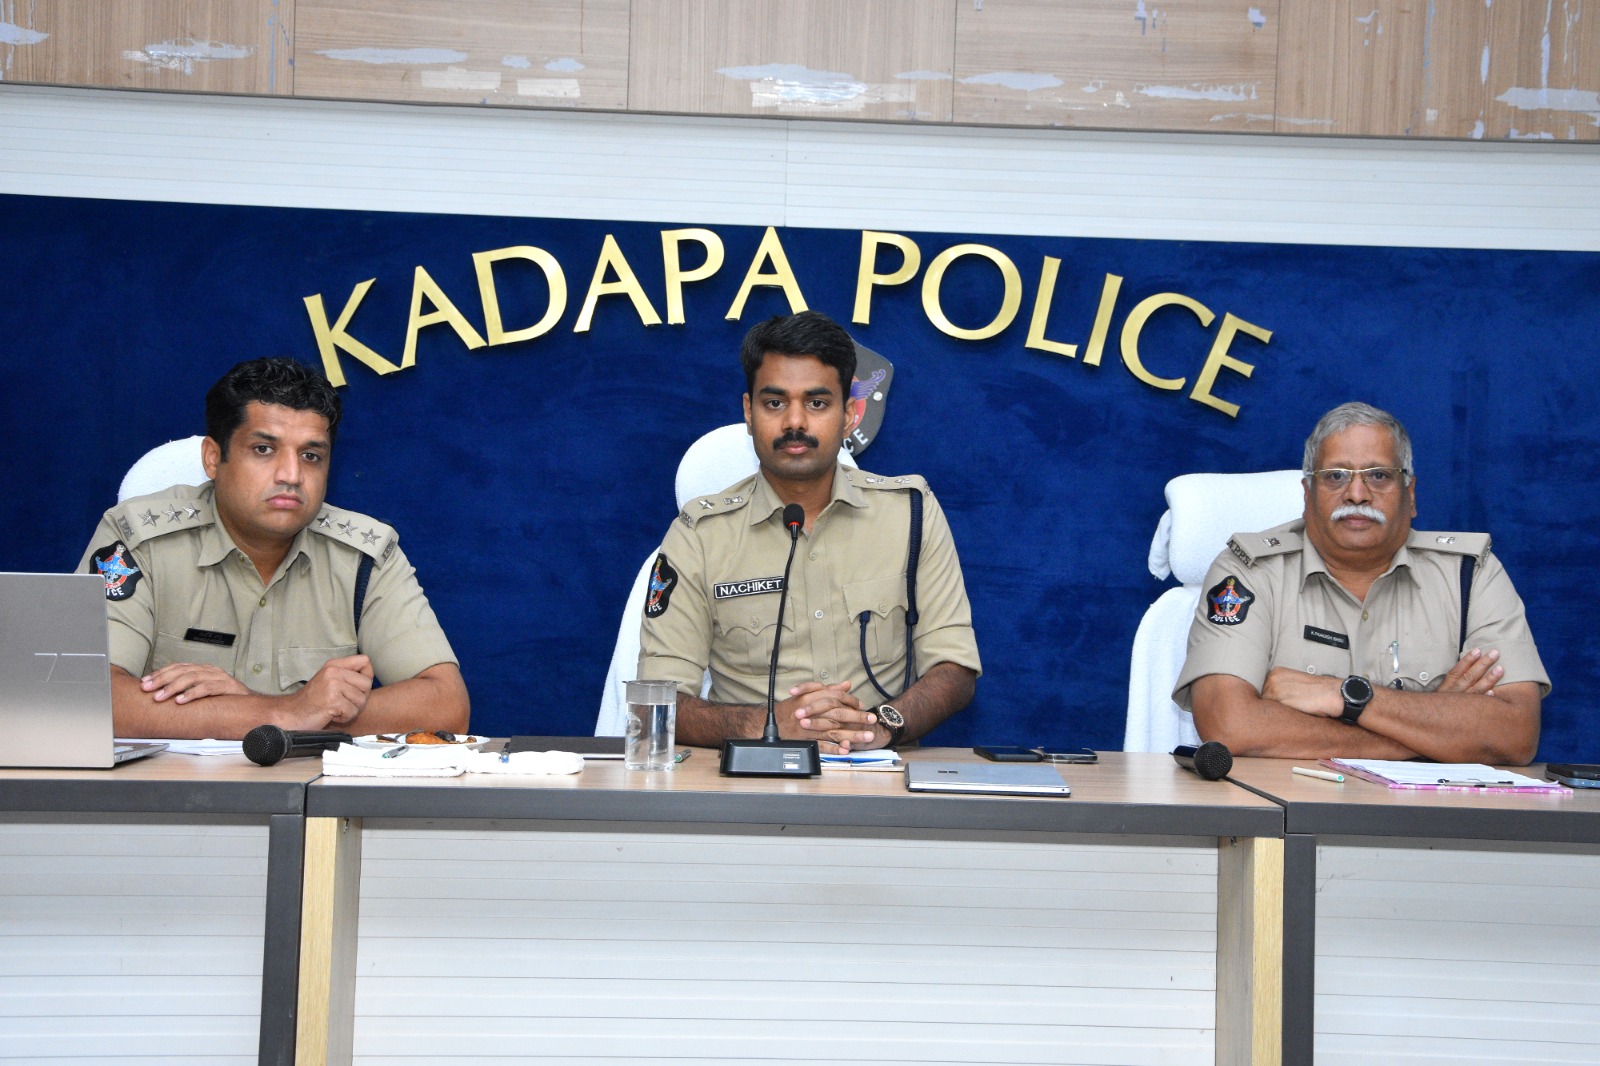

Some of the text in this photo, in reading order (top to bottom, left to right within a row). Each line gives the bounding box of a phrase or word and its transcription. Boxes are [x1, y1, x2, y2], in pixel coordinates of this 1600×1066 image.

[303, 226, 1274, 418] KADAPA POLICE
[106, 587, 125, 596] ICE
[720, 580, 782, 595] NACHIKET
